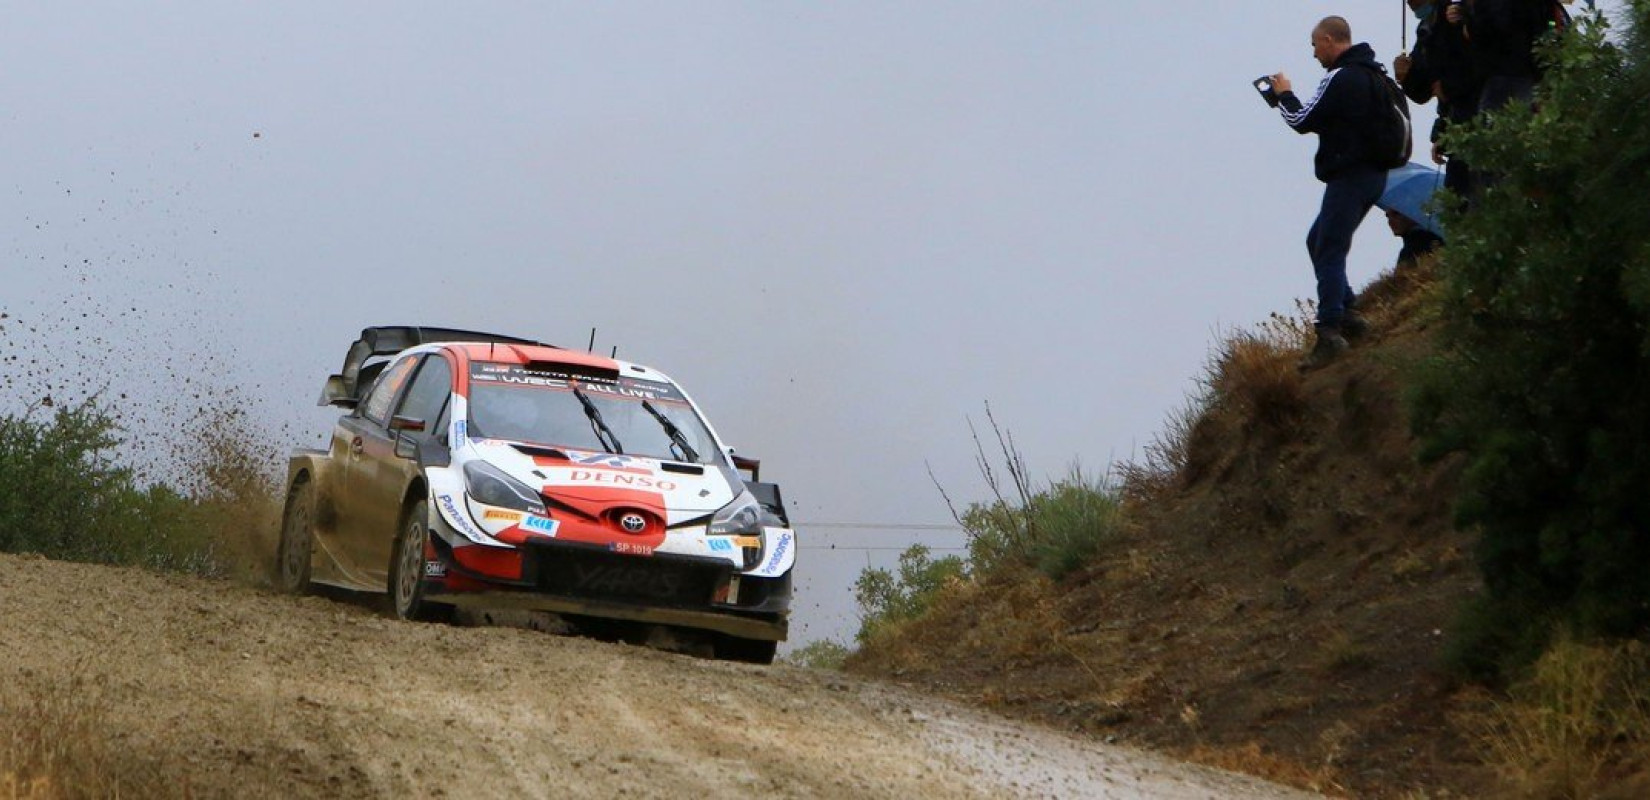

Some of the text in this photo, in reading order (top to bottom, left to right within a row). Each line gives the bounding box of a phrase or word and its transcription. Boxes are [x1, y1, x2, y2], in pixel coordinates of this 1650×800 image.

[587, 384, 616, 394] ALL
[620, 388, 655, 399] LIVE
[571, 471, 676, 490] DENSO
[616, 542, 653, 555] SP 1019
[765, 533, 792, 575] Panasonic
